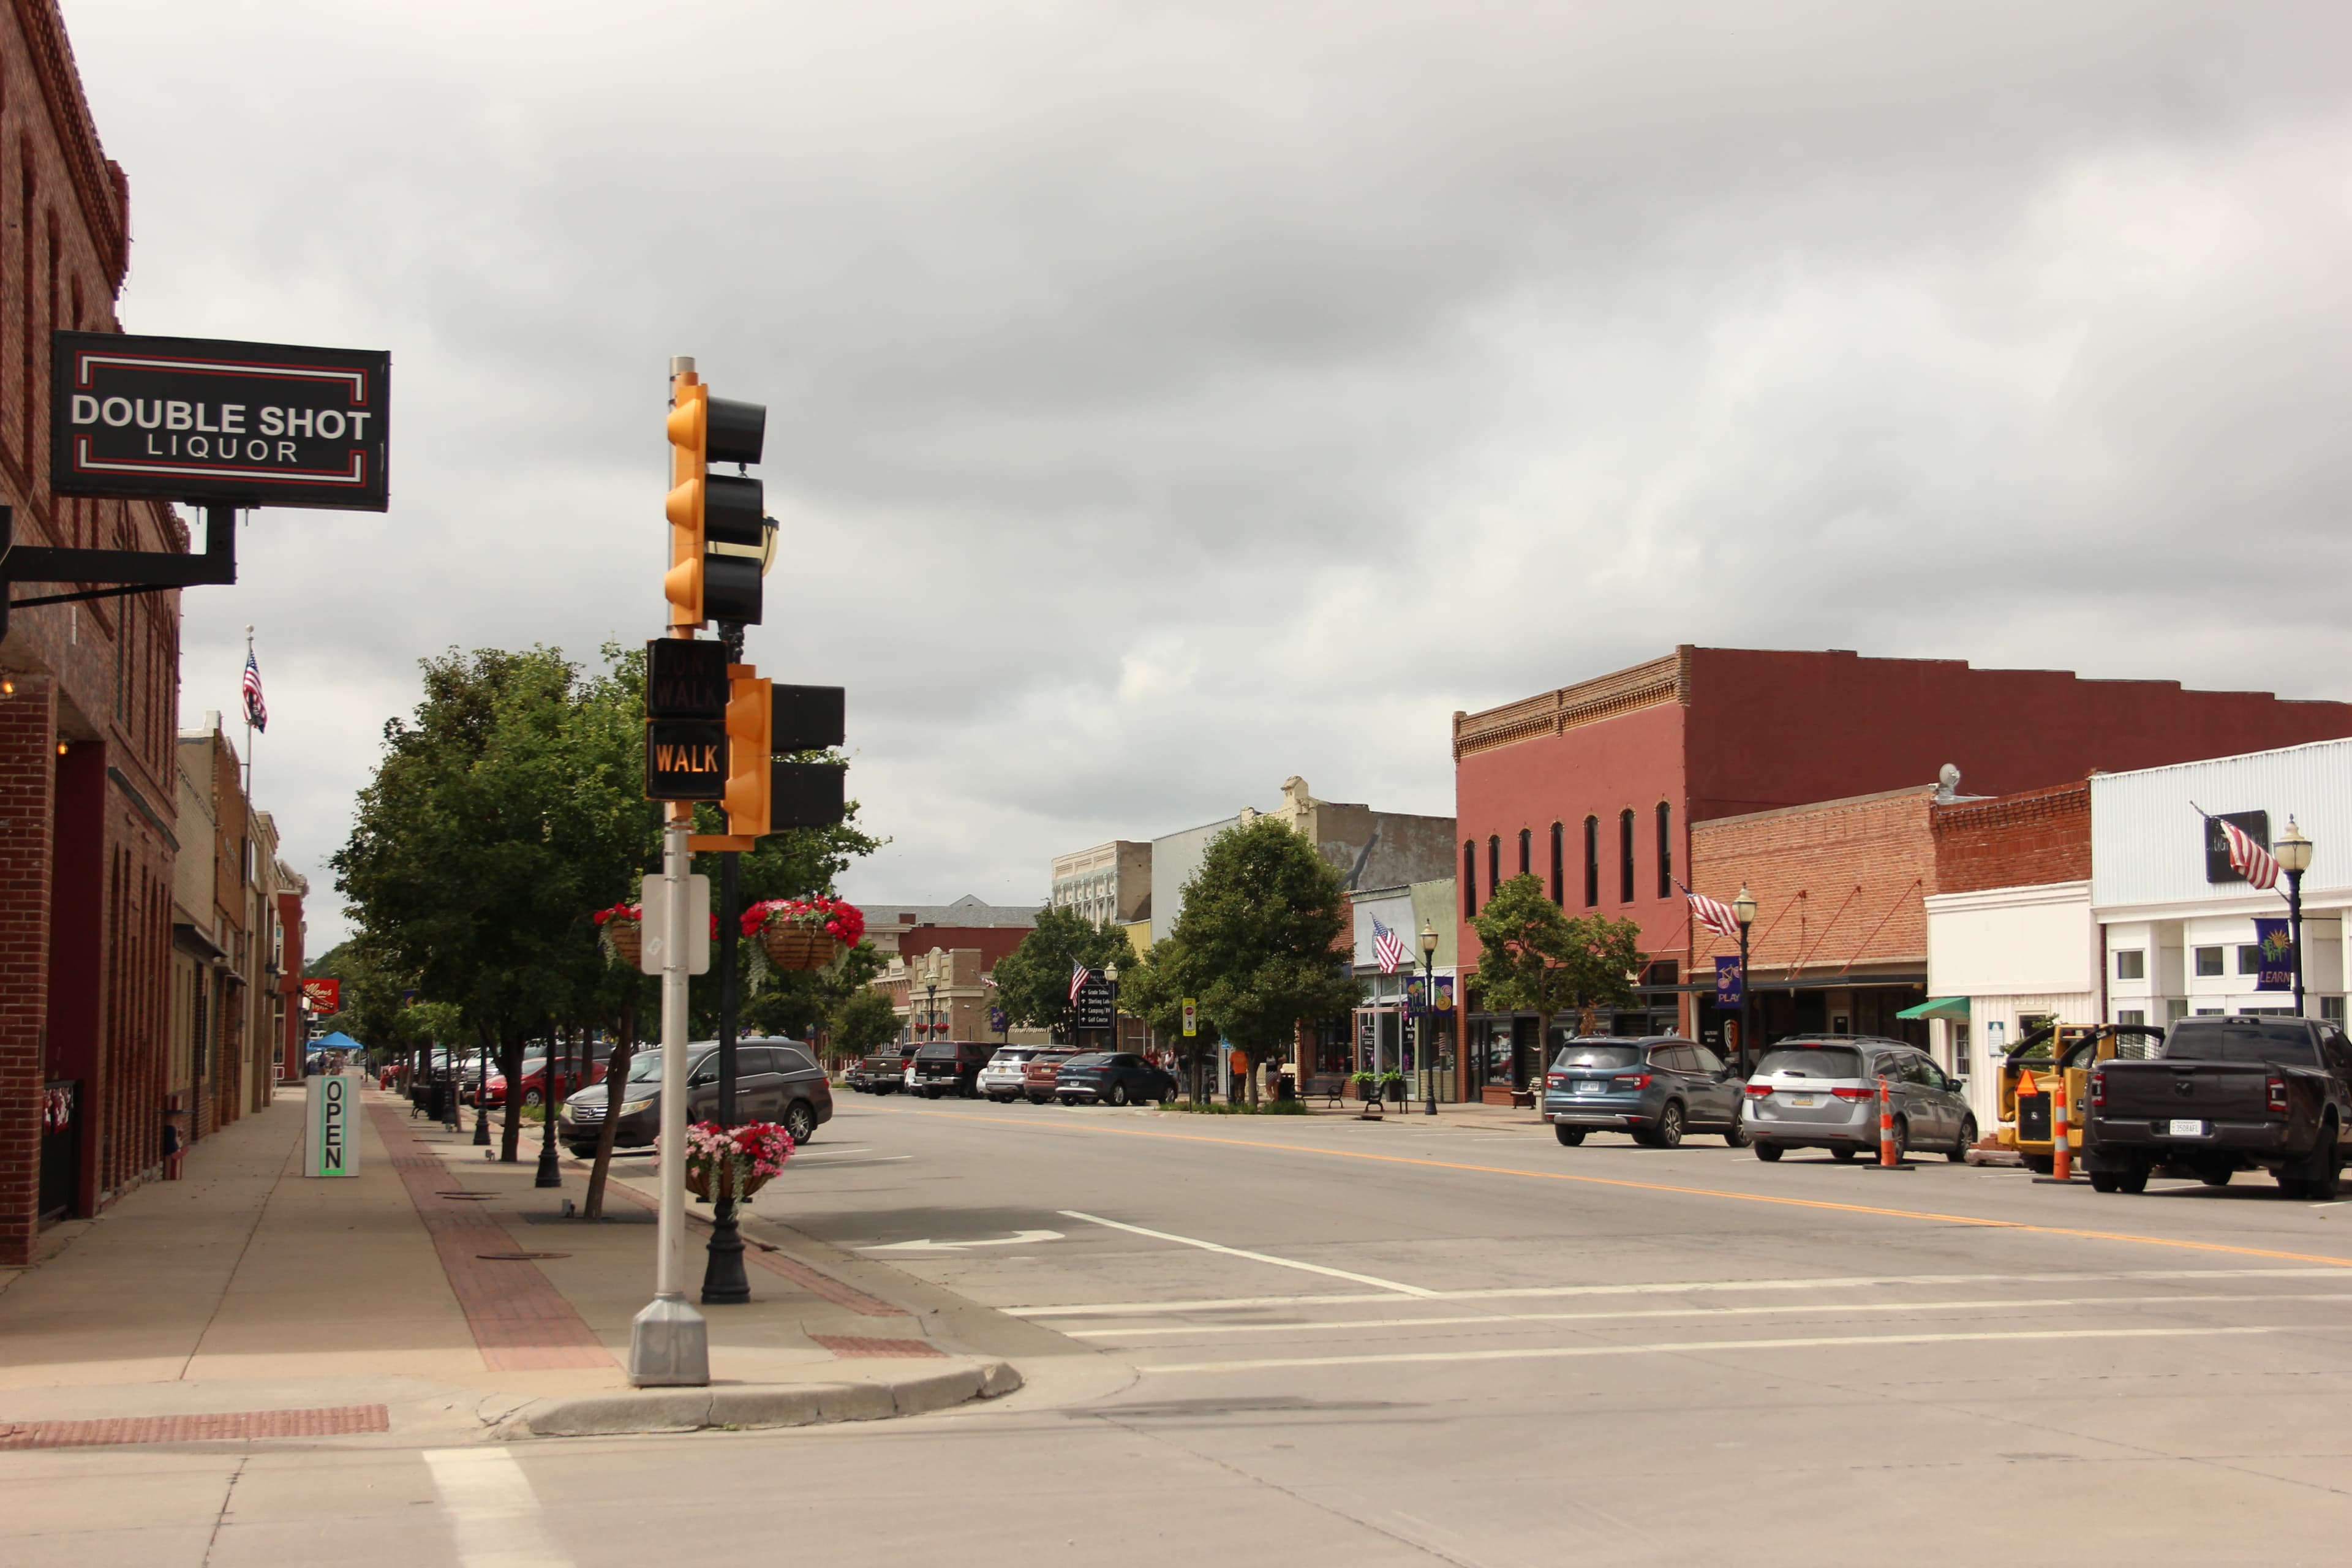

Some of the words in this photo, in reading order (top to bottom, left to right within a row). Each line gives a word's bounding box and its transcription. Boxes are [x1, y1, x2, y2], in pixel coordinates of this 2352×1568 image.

[72, 394, 246, 434] DOUBLE
[259, 405, 371, 440] SHOT
[147, 433, 298, 462] LIQUOR
[657, 680, 717, 707] WALK
[655, 744, 718, 772] WALK
[2260, 970, 2290, 983] LEARN
[1718, 993, 1740, 1003] PLAY
[325, 1080, 342, 1168] OPEN
